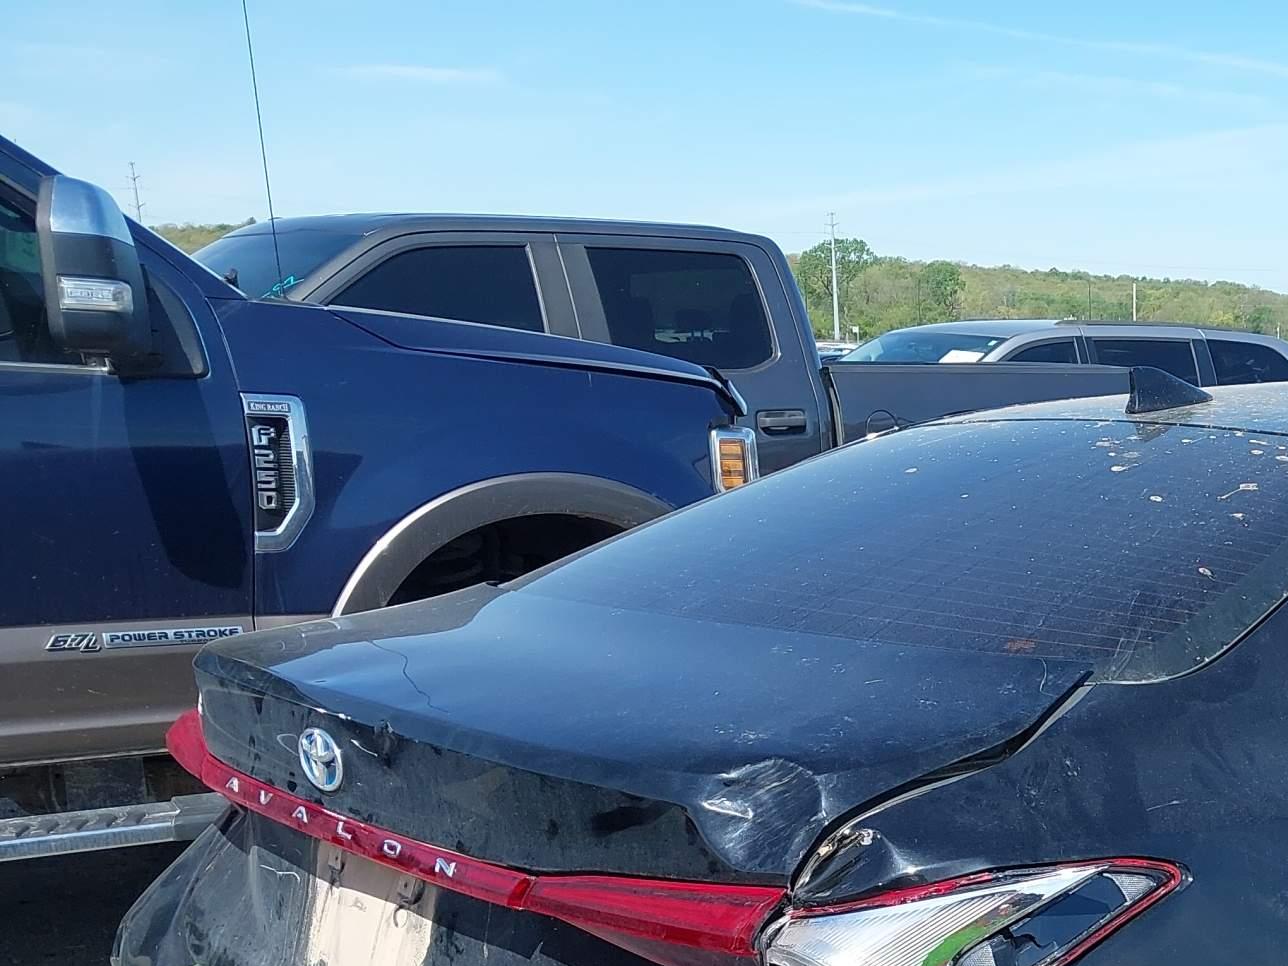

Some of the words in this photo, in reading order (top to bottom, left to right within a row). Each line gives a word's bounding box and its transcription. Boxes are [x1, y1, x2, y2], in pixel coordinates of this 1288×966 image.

[108, 632, 169, 643] POWER
[173, 628, 239, 639] STROKE
[224, 776, 457, 878] AVALON
